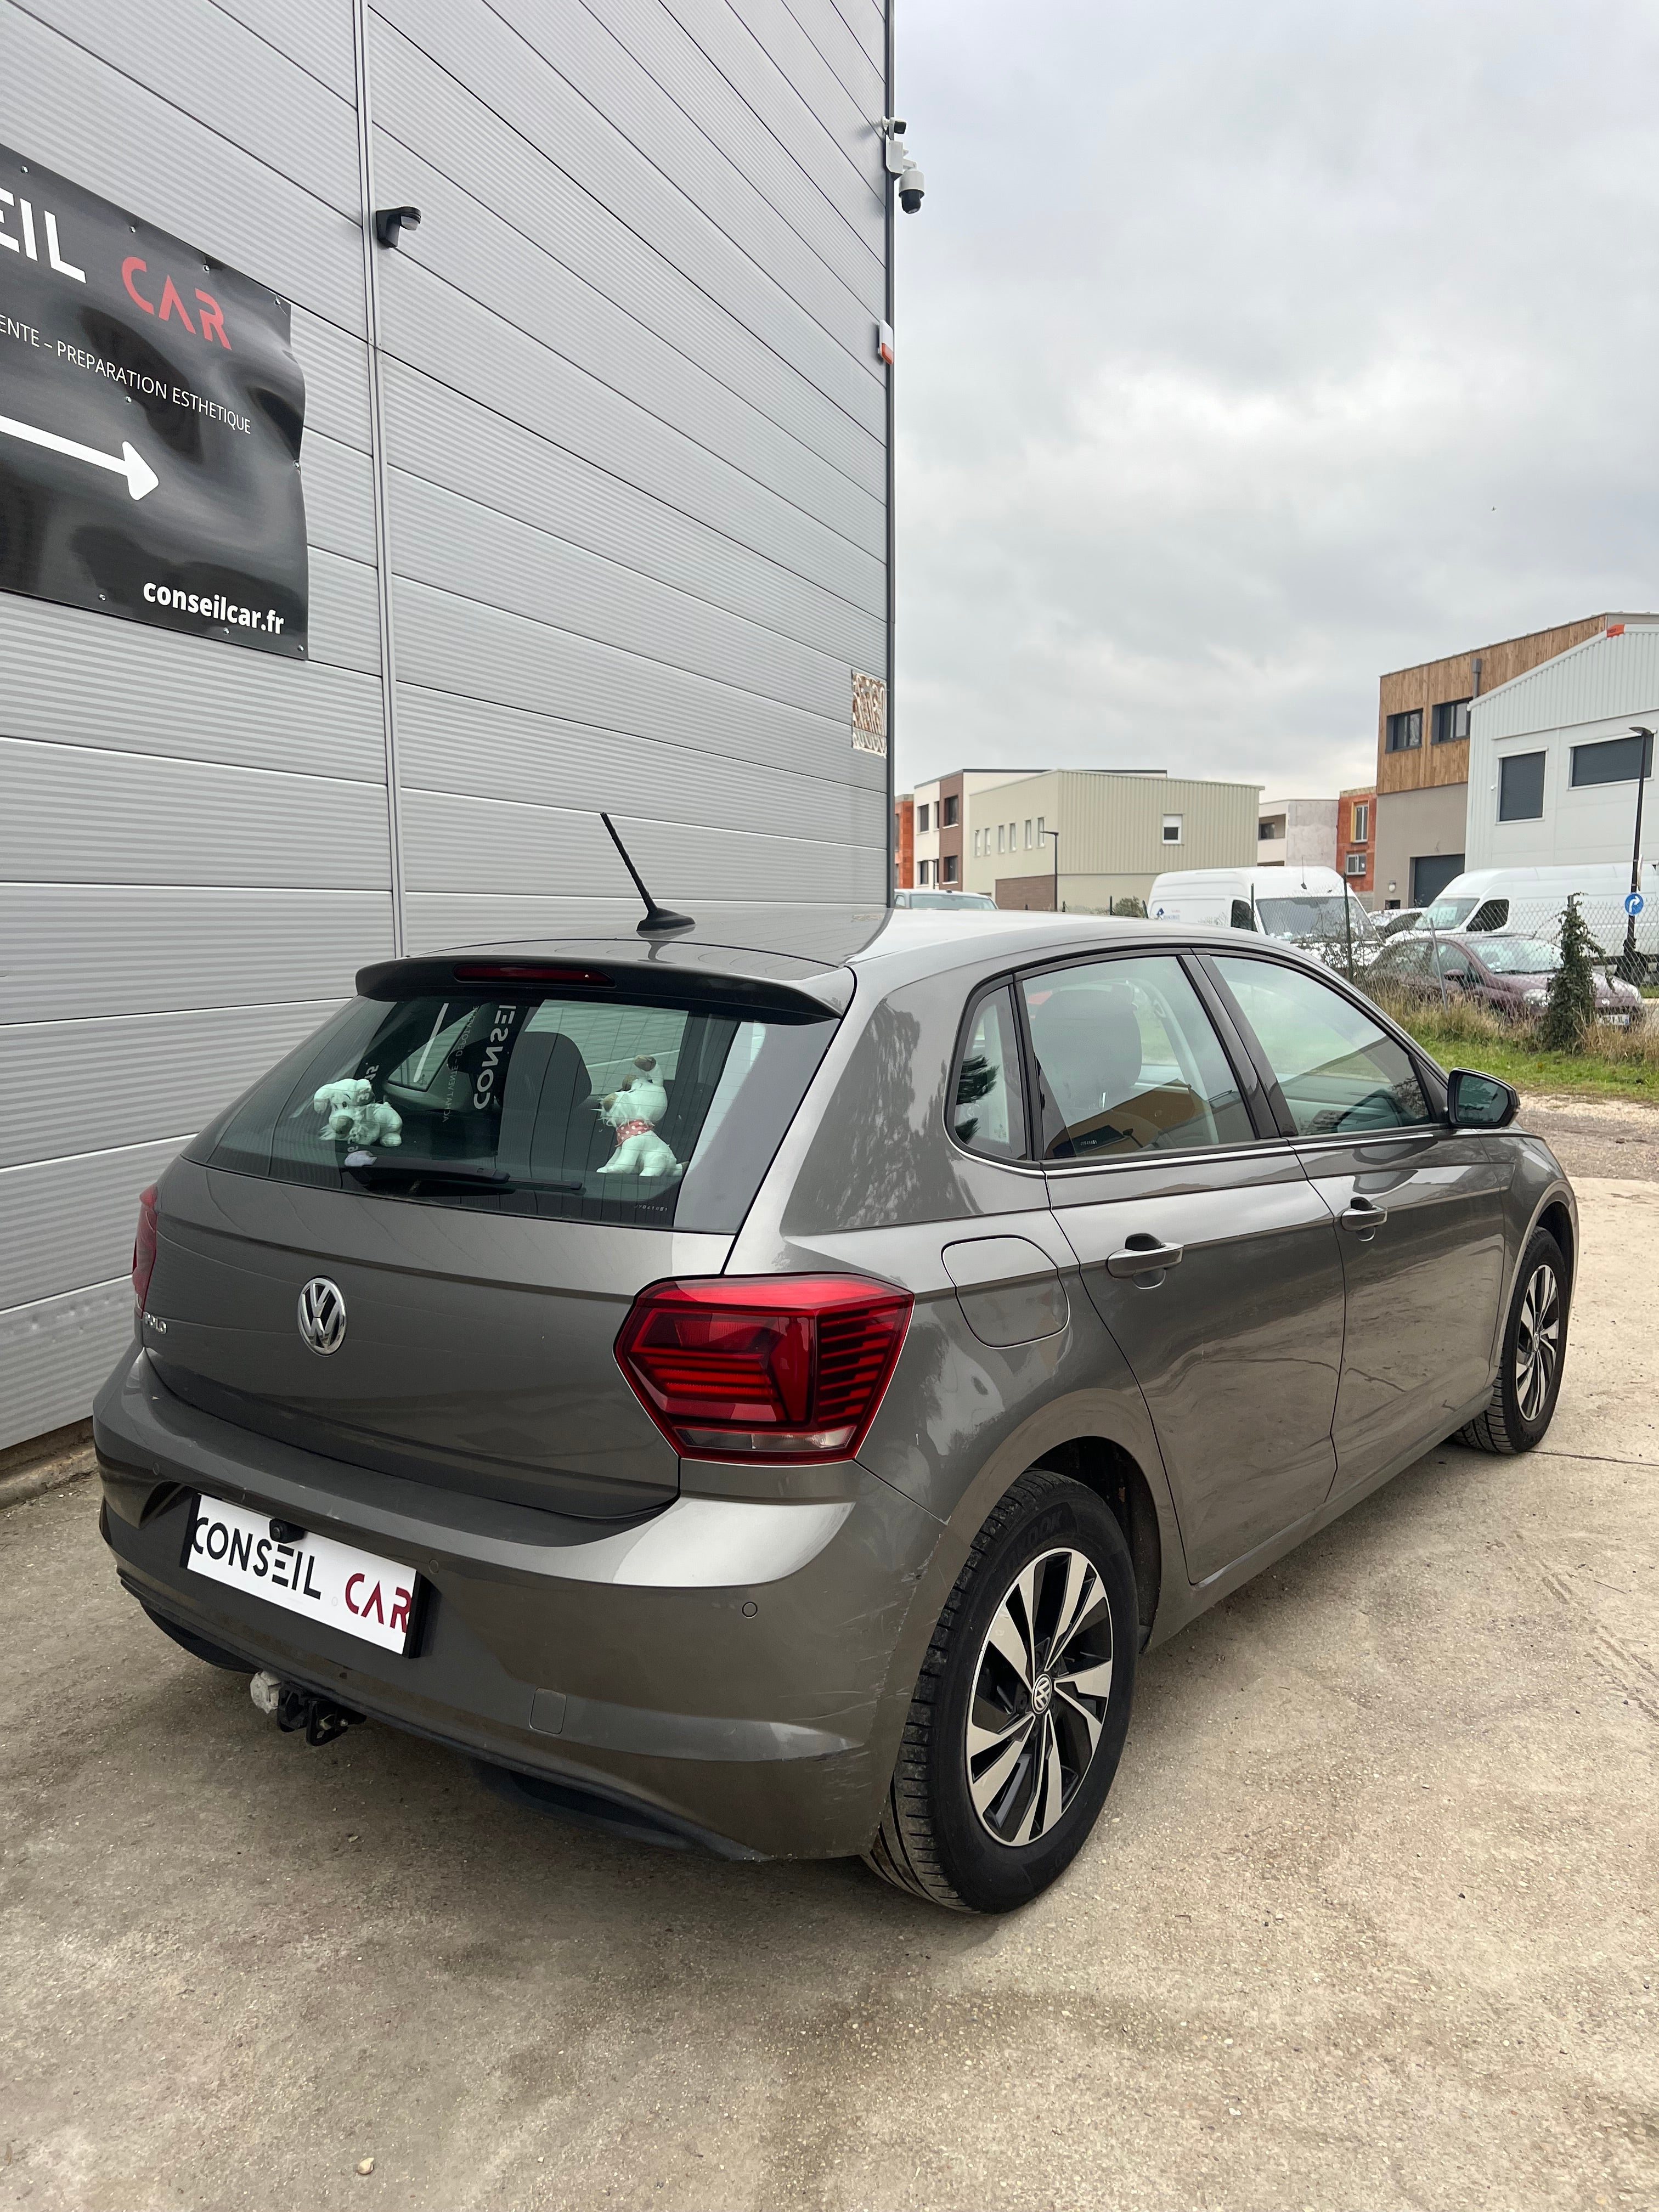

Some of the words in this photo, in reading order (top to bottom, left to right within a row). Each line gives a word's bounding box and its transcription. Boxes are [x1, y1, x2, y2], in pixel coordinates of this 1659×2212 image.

[121, 256, 233, 351] CAR
[57, 340, 167, 399] PREPARATION
[172, 387, 251, 435] ESTHETIQUE
[143, 582, 285, 634] conseilcar.fr
[192, 1517, 321, 1600] CONSEIL
[345, 1573, 411, 1634] CAR
